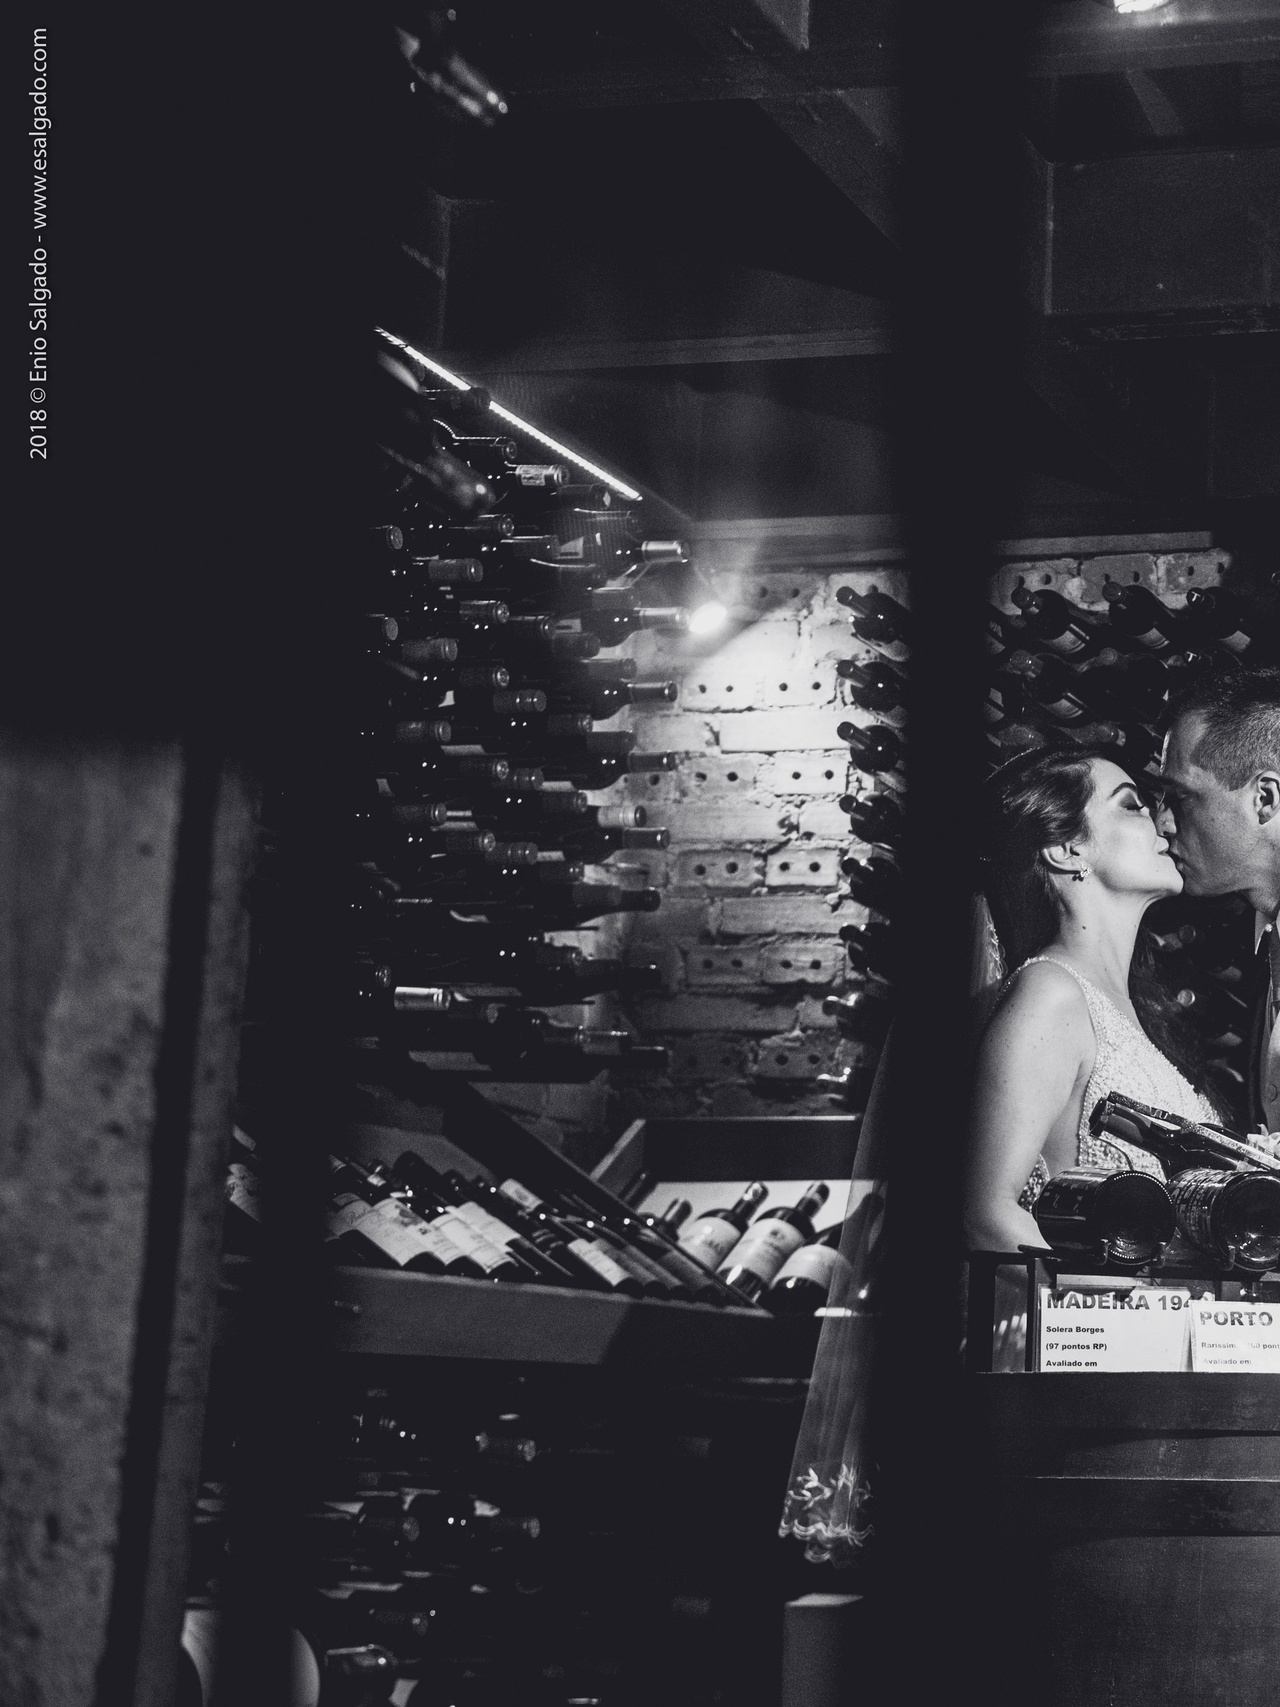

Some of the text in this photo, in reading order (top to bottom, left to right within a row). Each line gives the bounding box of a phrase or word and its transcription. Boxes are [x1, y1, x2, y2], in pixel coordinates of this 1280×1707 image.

[1046, 1293, 1196, 1311] MADEIRA 194
[1199, 1310, 1273, 1327] PORTO
[1045, 1325, 1105, 1335] Solera Borges
[1045, 1342, 1108, 1352] (97 pontos RP)
[1201, 1341, 1238, 1350] Rarissim
[1045, 1359, 1083, 1367] Avaliado
